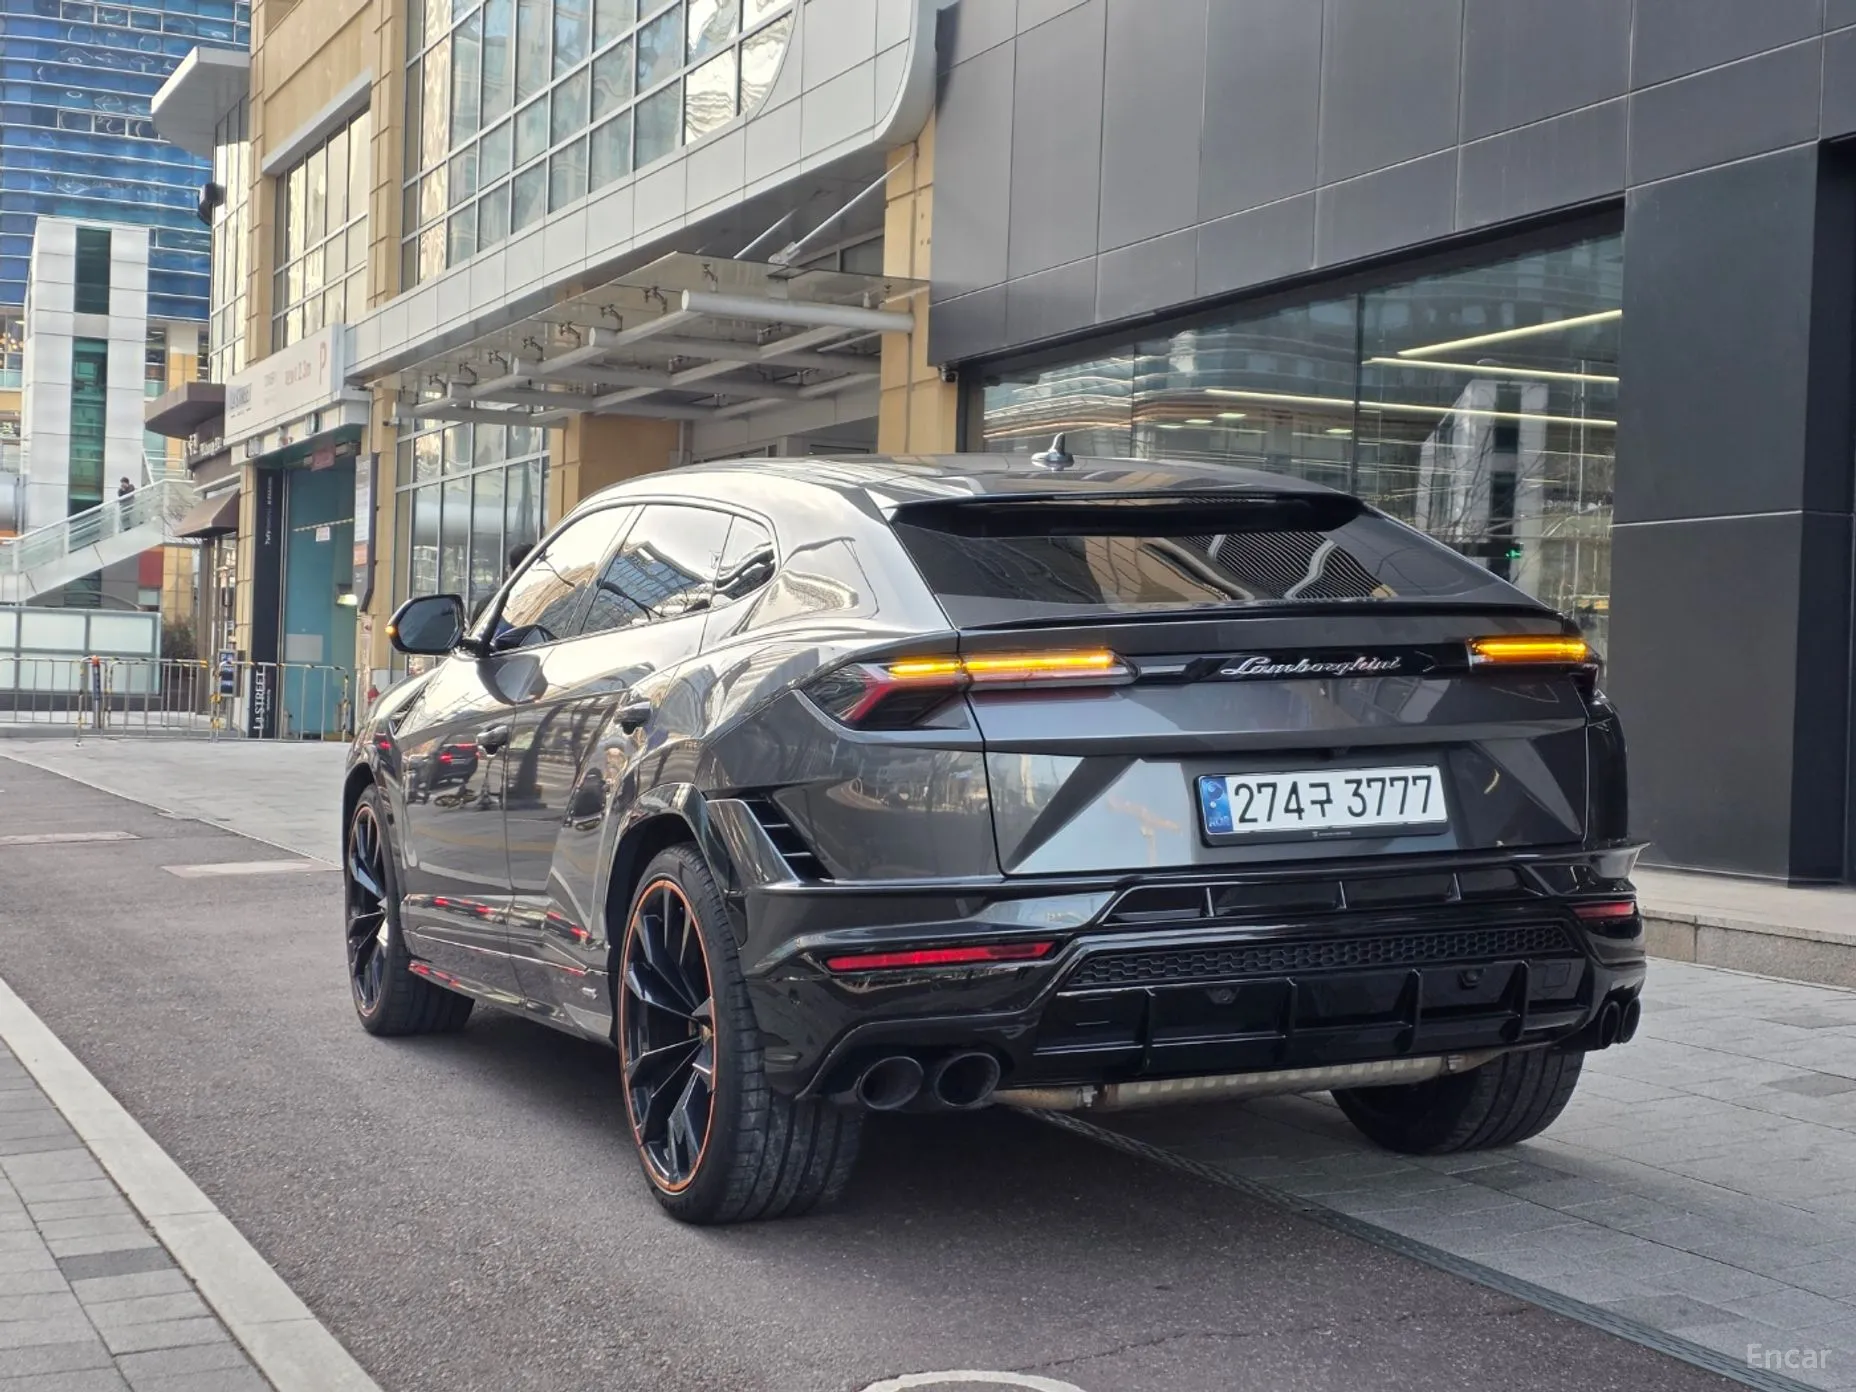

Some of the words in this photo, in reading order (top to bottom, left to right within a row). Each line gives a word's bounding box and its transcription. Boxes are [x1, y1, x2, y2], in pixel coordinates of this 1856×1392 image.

[319, 341, 327, 385] P
[1220, 656, 1402, 676] Lamborghini
[1234, 780, 1333, 824] 274구
[1344, 775, 1432, 817] 3777
